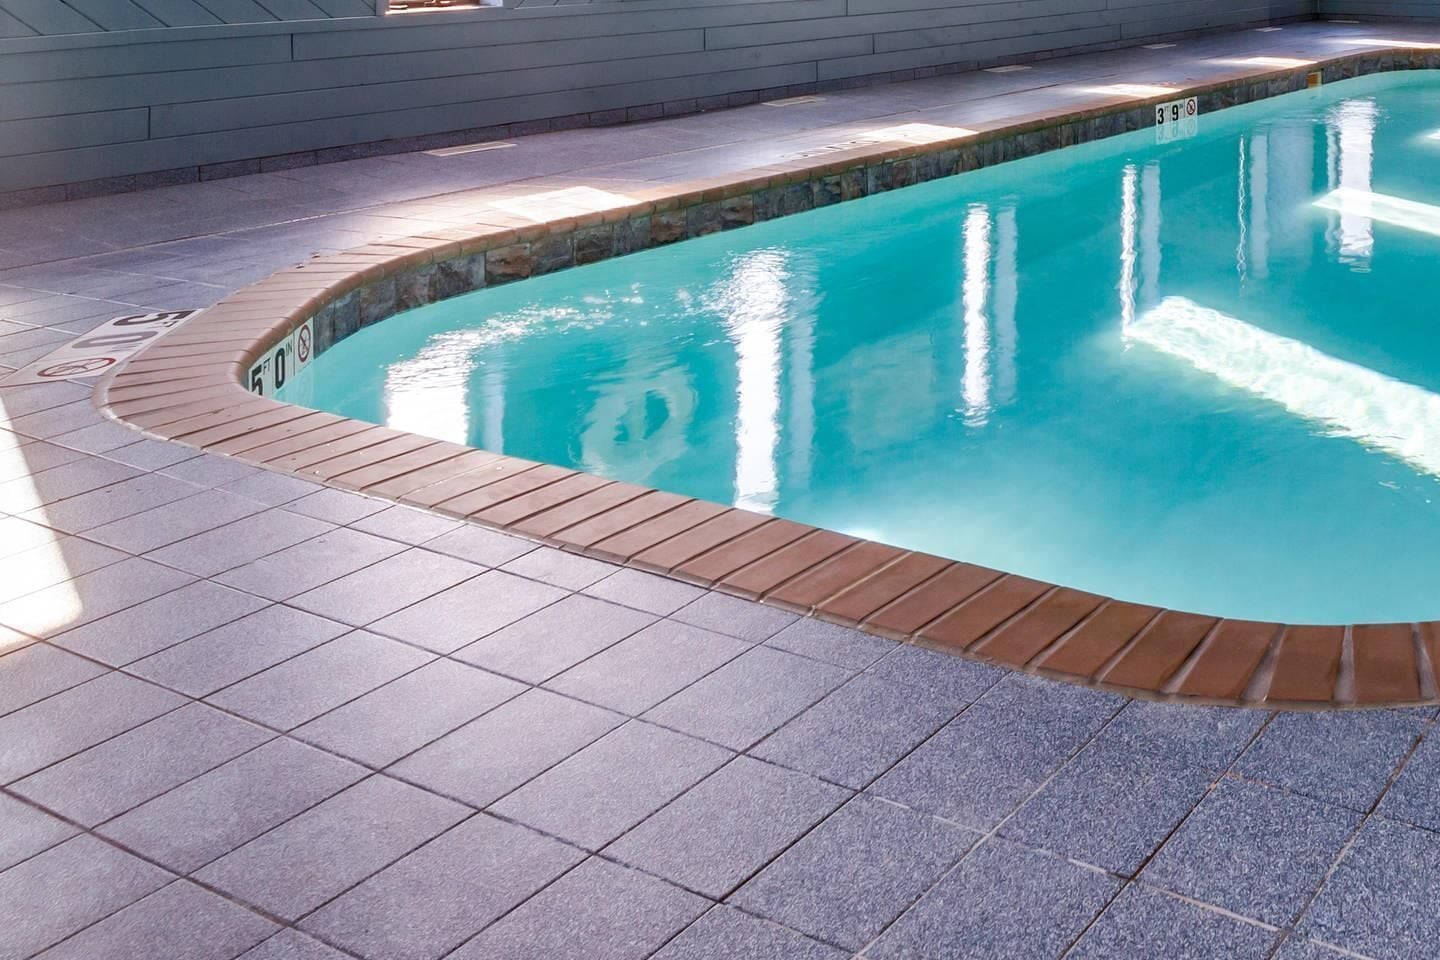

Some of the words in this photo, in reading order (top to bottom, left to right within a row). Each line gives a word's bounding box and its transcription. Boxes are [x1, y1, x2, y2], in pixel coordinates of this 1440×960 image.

[1158, 108, 1164, 124] 3
[1172, 105, 1178, 121] 9
[251, 364, 264, 396] 5
[263, 357, 271, 375] FT
[274, 347, 286, 389] 0
[285, 339, 293, 356] IN
